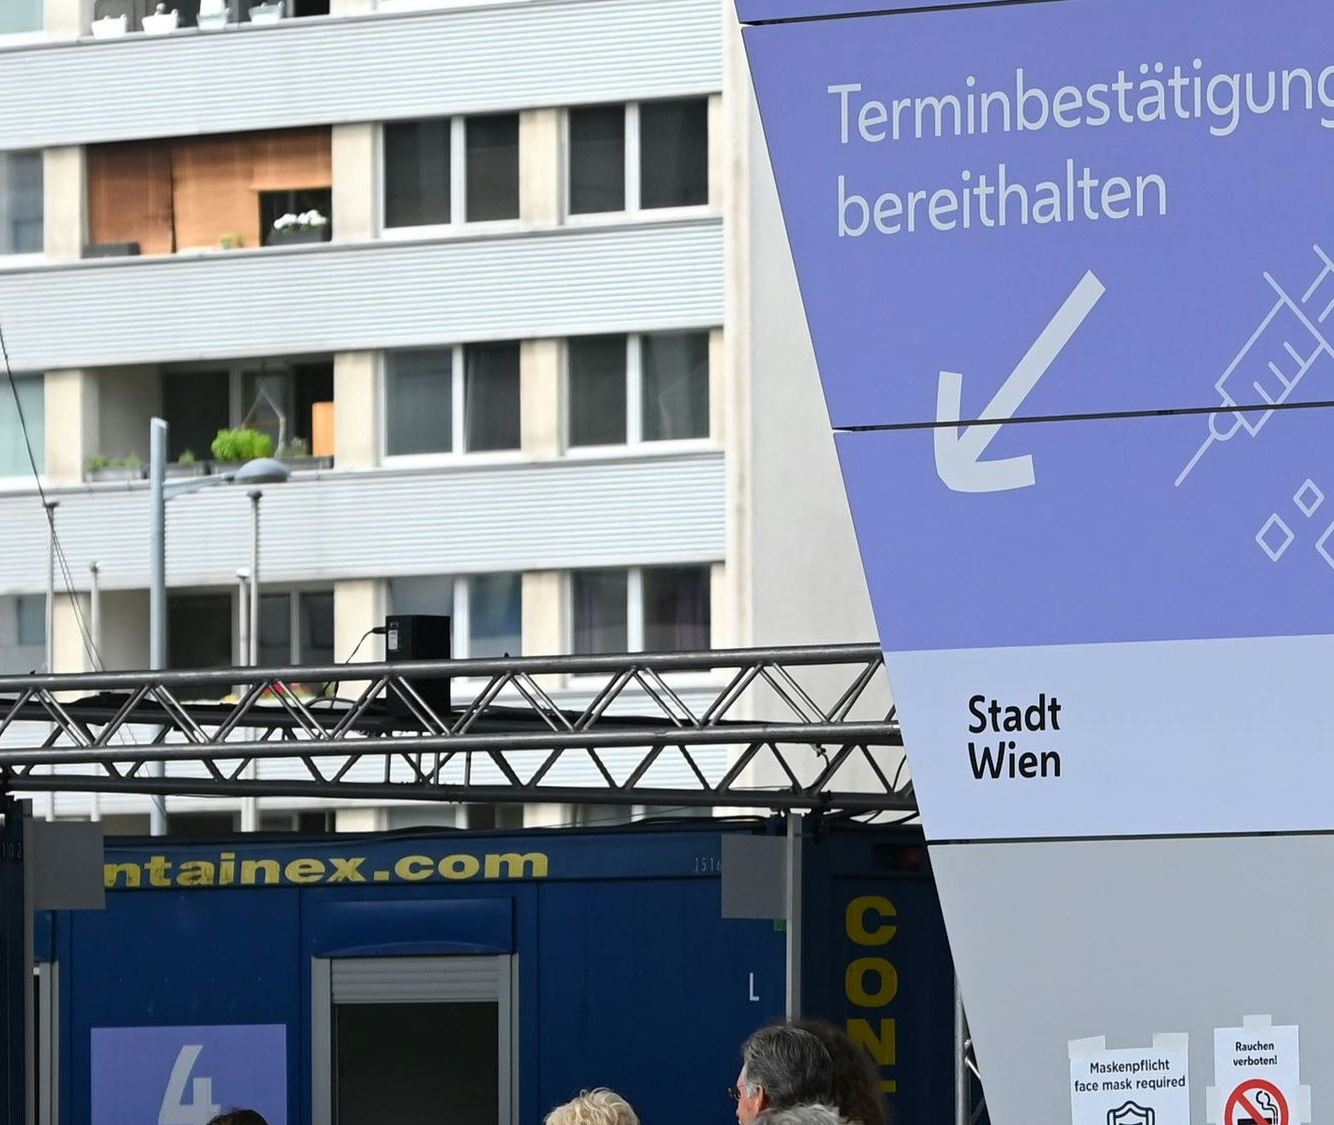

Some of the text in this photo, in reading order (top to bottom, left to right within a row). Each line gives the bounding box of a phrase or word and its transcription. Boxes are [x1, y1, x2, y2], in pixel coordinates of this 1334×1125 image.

[838, 158, 1167, 237] bereithalten
[968, 693, 1061, 734] Stadt
[968, 741, 1061, 779] Wien
[103, 851, 548, 888] ntainex.com
[845, 895, 898, 1093] CON
[1233, 1055, 1278, 1067] verboten!
[1235, 1041, 1275, 1052] Rauchen
[1074, 1075, 1186, 1092] face mask required
[1090, 1059, 1170, 1074] Maskenpflicht
